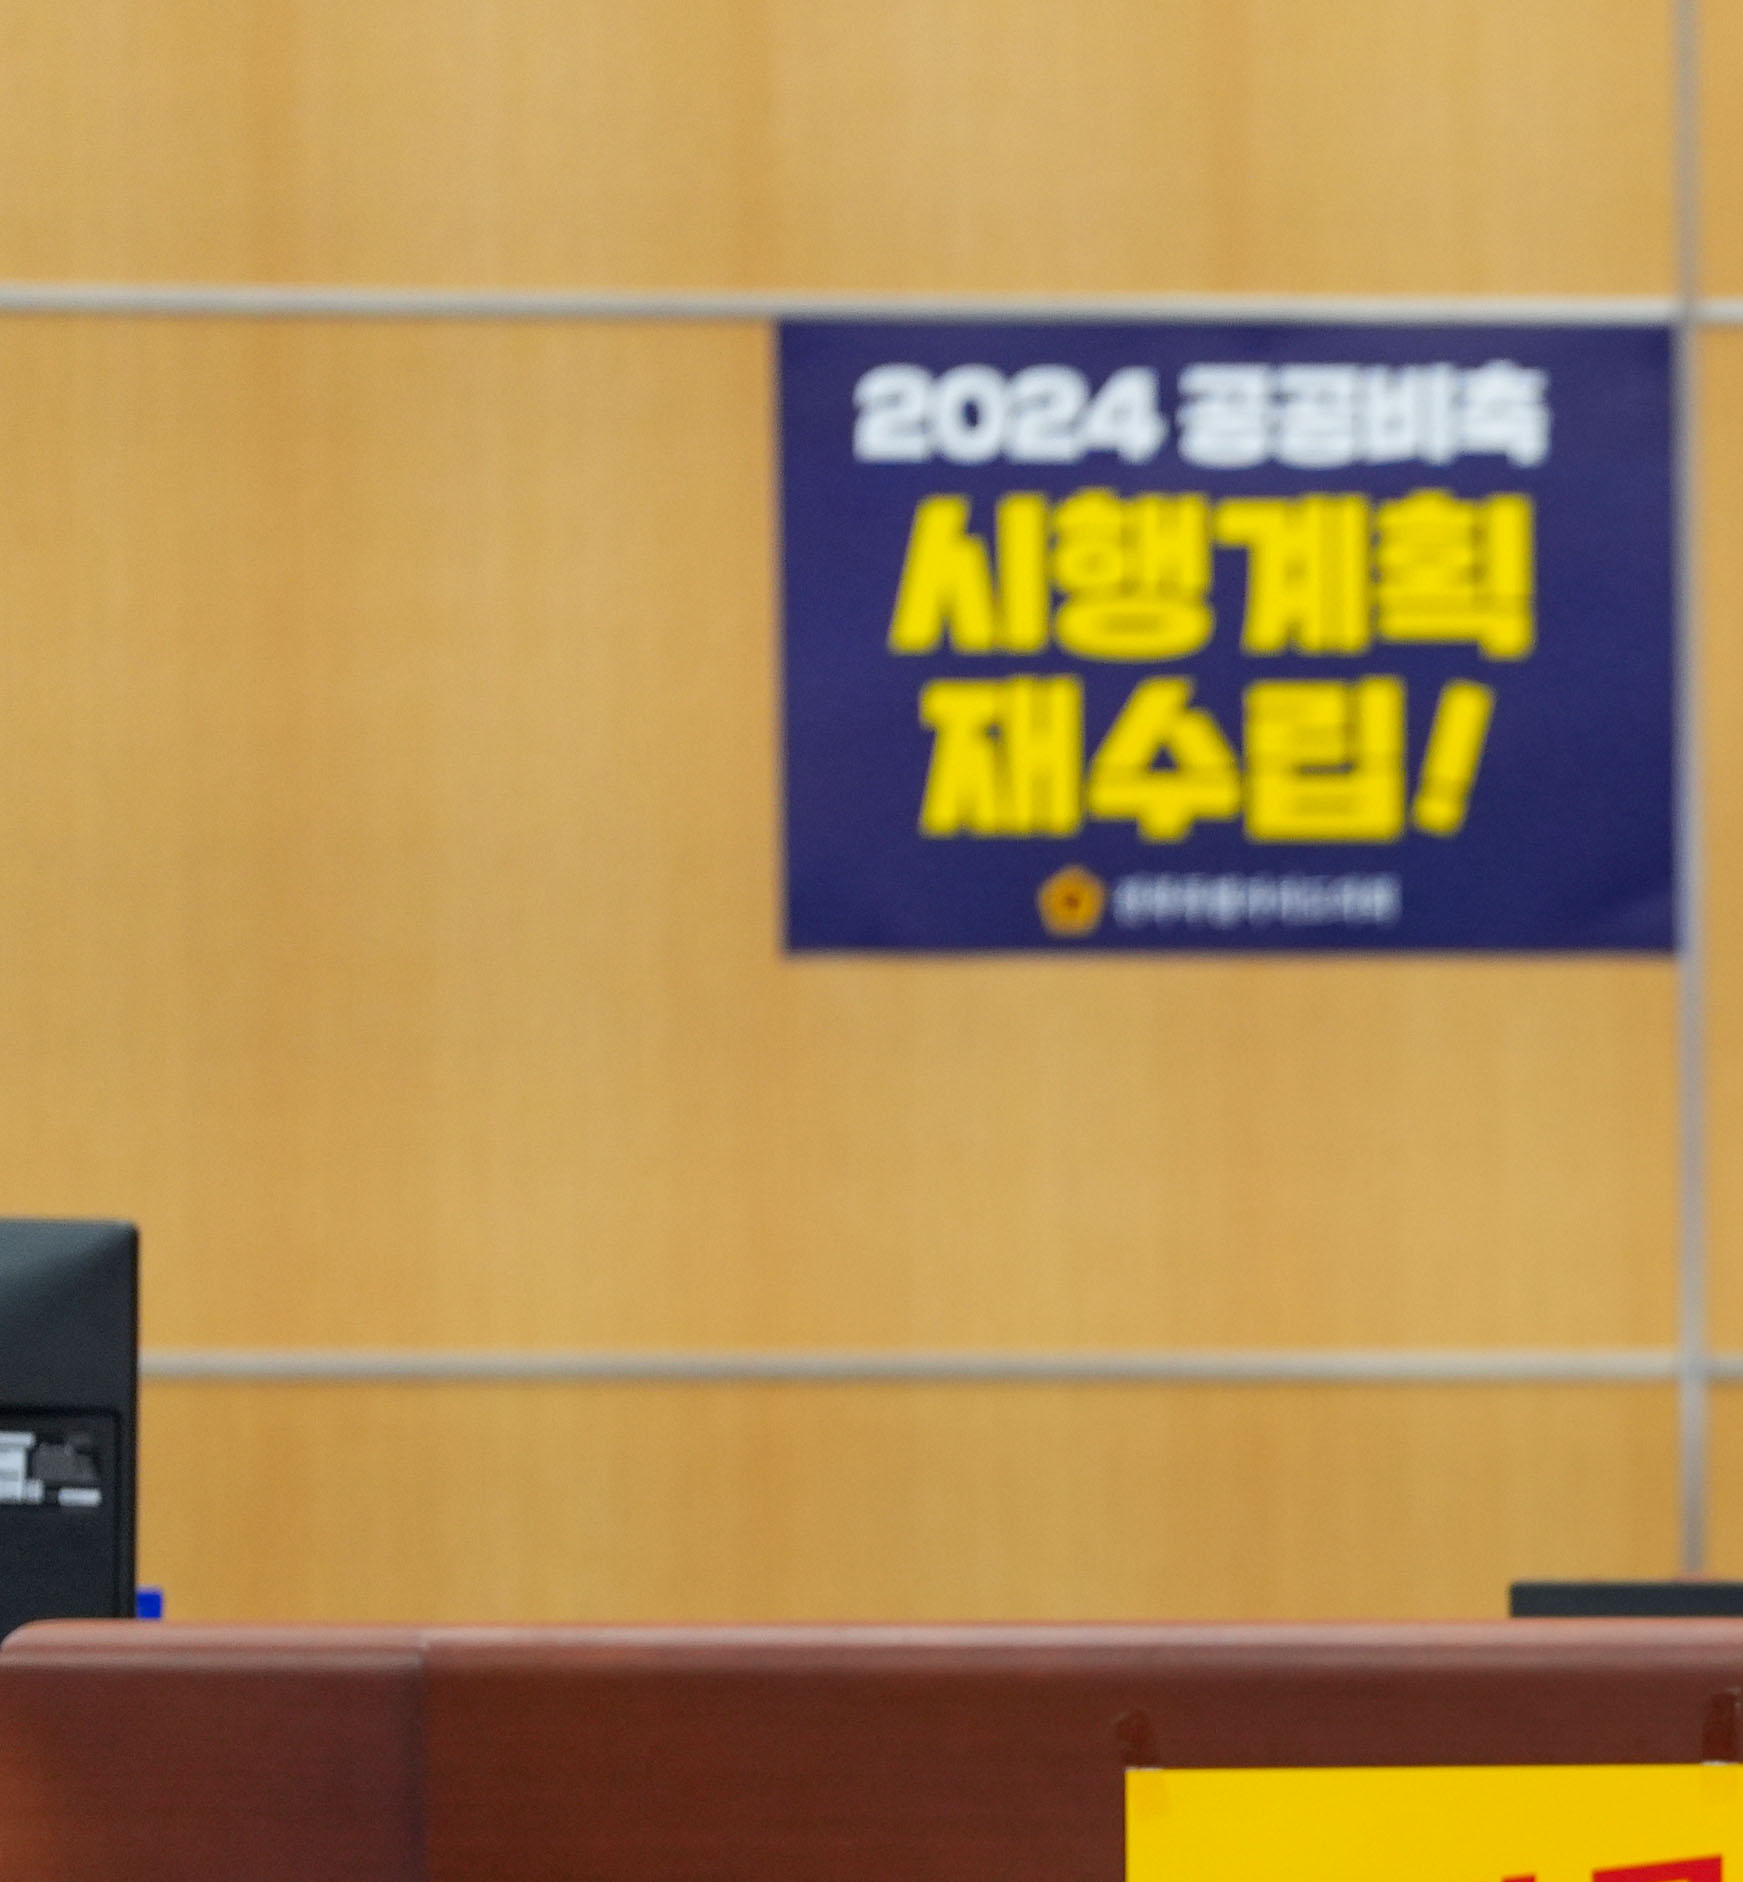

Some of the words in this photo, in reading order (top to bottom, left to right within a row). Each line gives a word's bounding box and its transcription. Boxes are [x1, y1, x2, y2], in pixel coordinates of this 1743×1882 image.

[854, 364, 1166, 463] 2024
[1180, 360, 1549, 468] 공공비축
[890, 488, 1534, 661] 시행계획
[920, 675, 1494, 842] 재수립!
